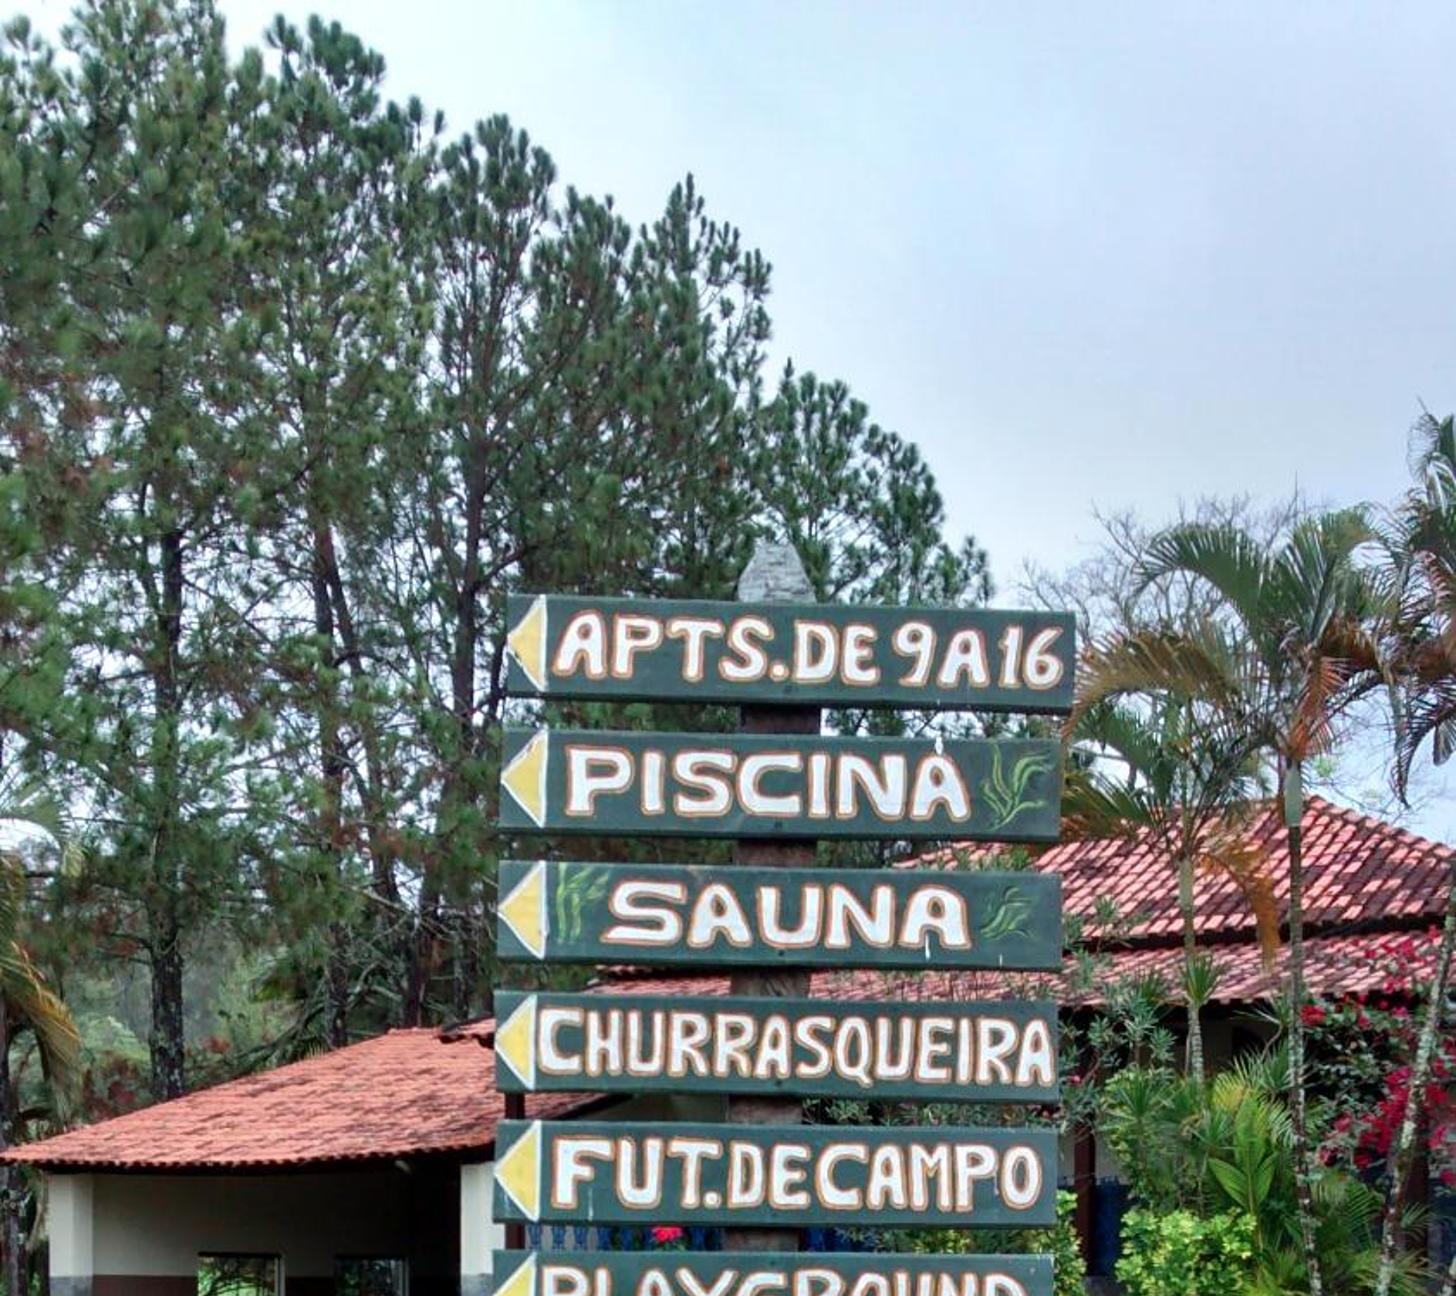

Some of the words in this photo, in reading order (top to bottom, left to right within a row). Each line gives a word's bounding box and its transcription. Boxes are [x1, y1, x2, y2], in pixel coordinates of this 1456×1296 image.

[565, 744, 971, 822] PISCINA
[600, 877, 971, 951] SAUNA
[537, 1006, 1056, 1088] CHURRASQUEIRA
